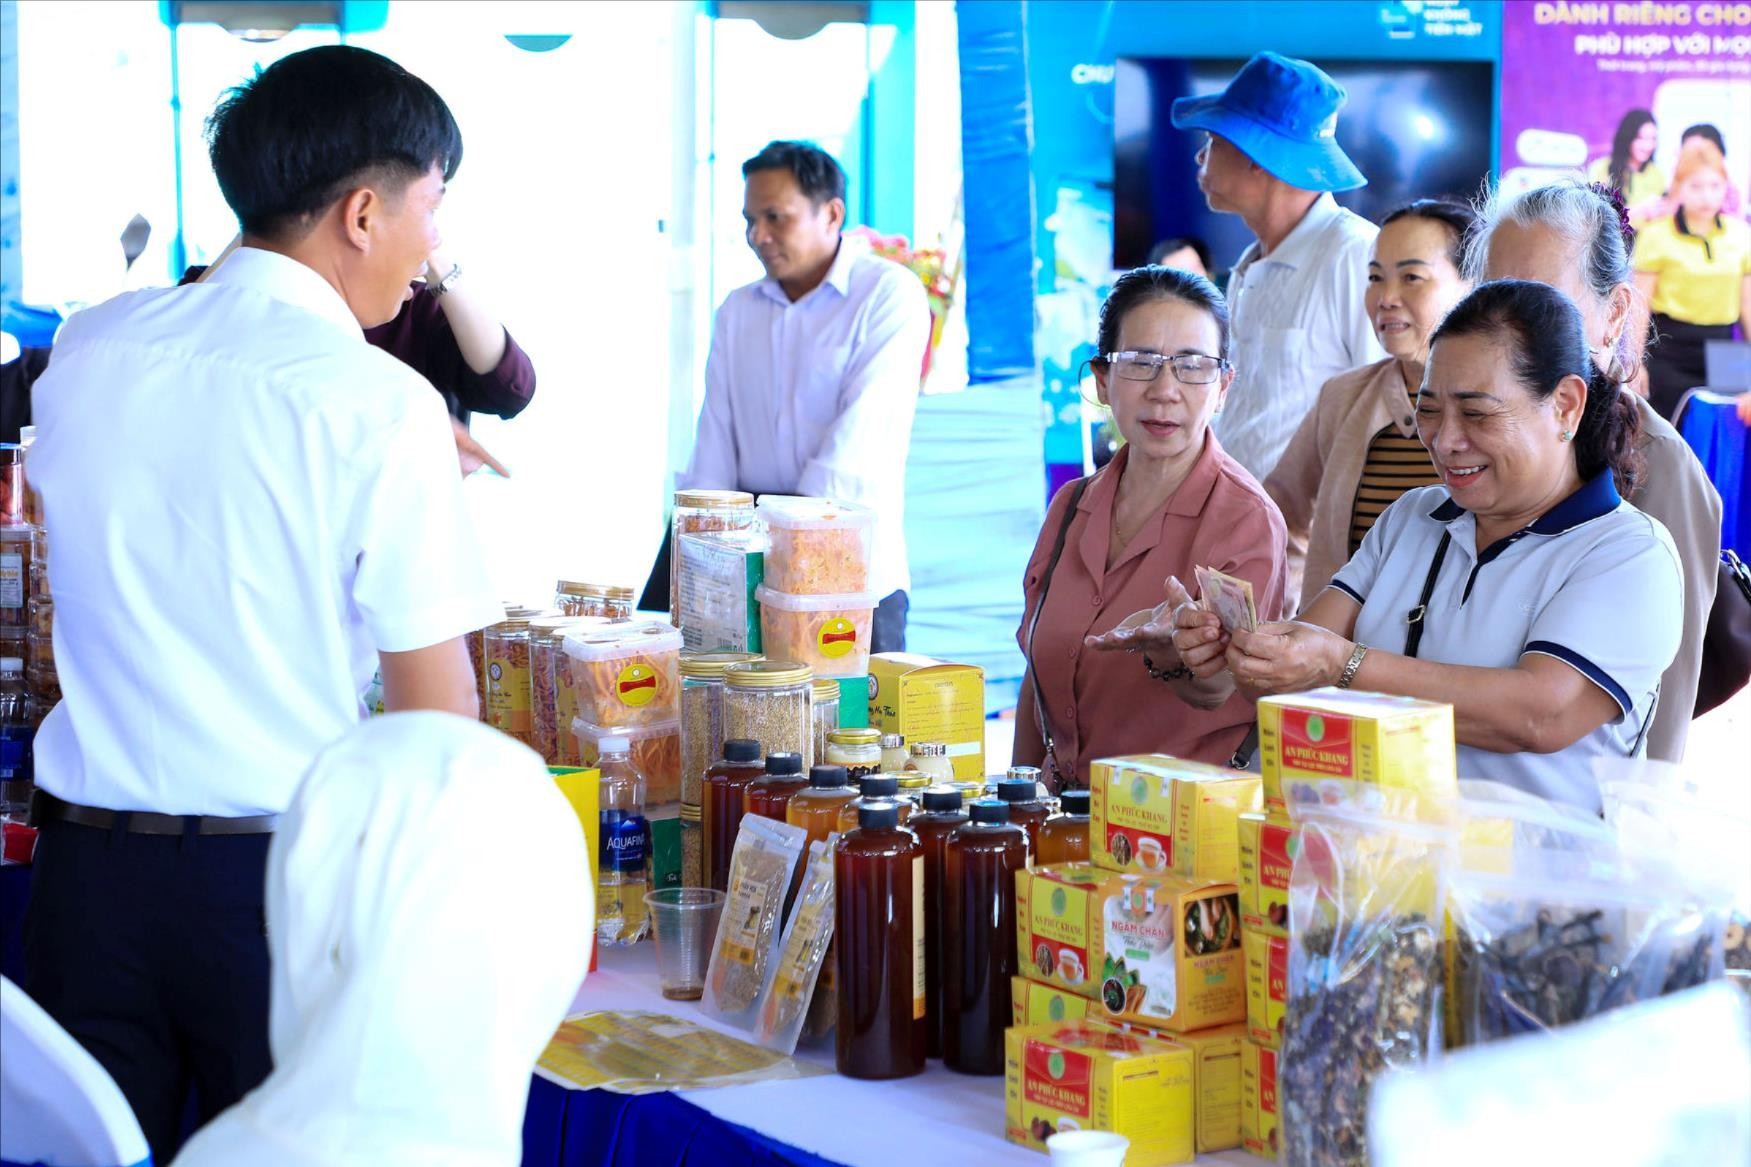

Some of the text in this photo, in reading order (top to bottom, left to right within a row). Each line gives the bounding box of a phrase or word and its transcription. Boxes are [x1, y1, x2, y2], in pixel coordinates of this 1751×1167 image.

[1534, 1, 1751, 26] DÀNH RIÊNG CHO
[1574, 31, 1621, 55] PHÙ
[1623, 33, 1671, 58] HỢP
[1672, 31, 1711, 55] VỚI
